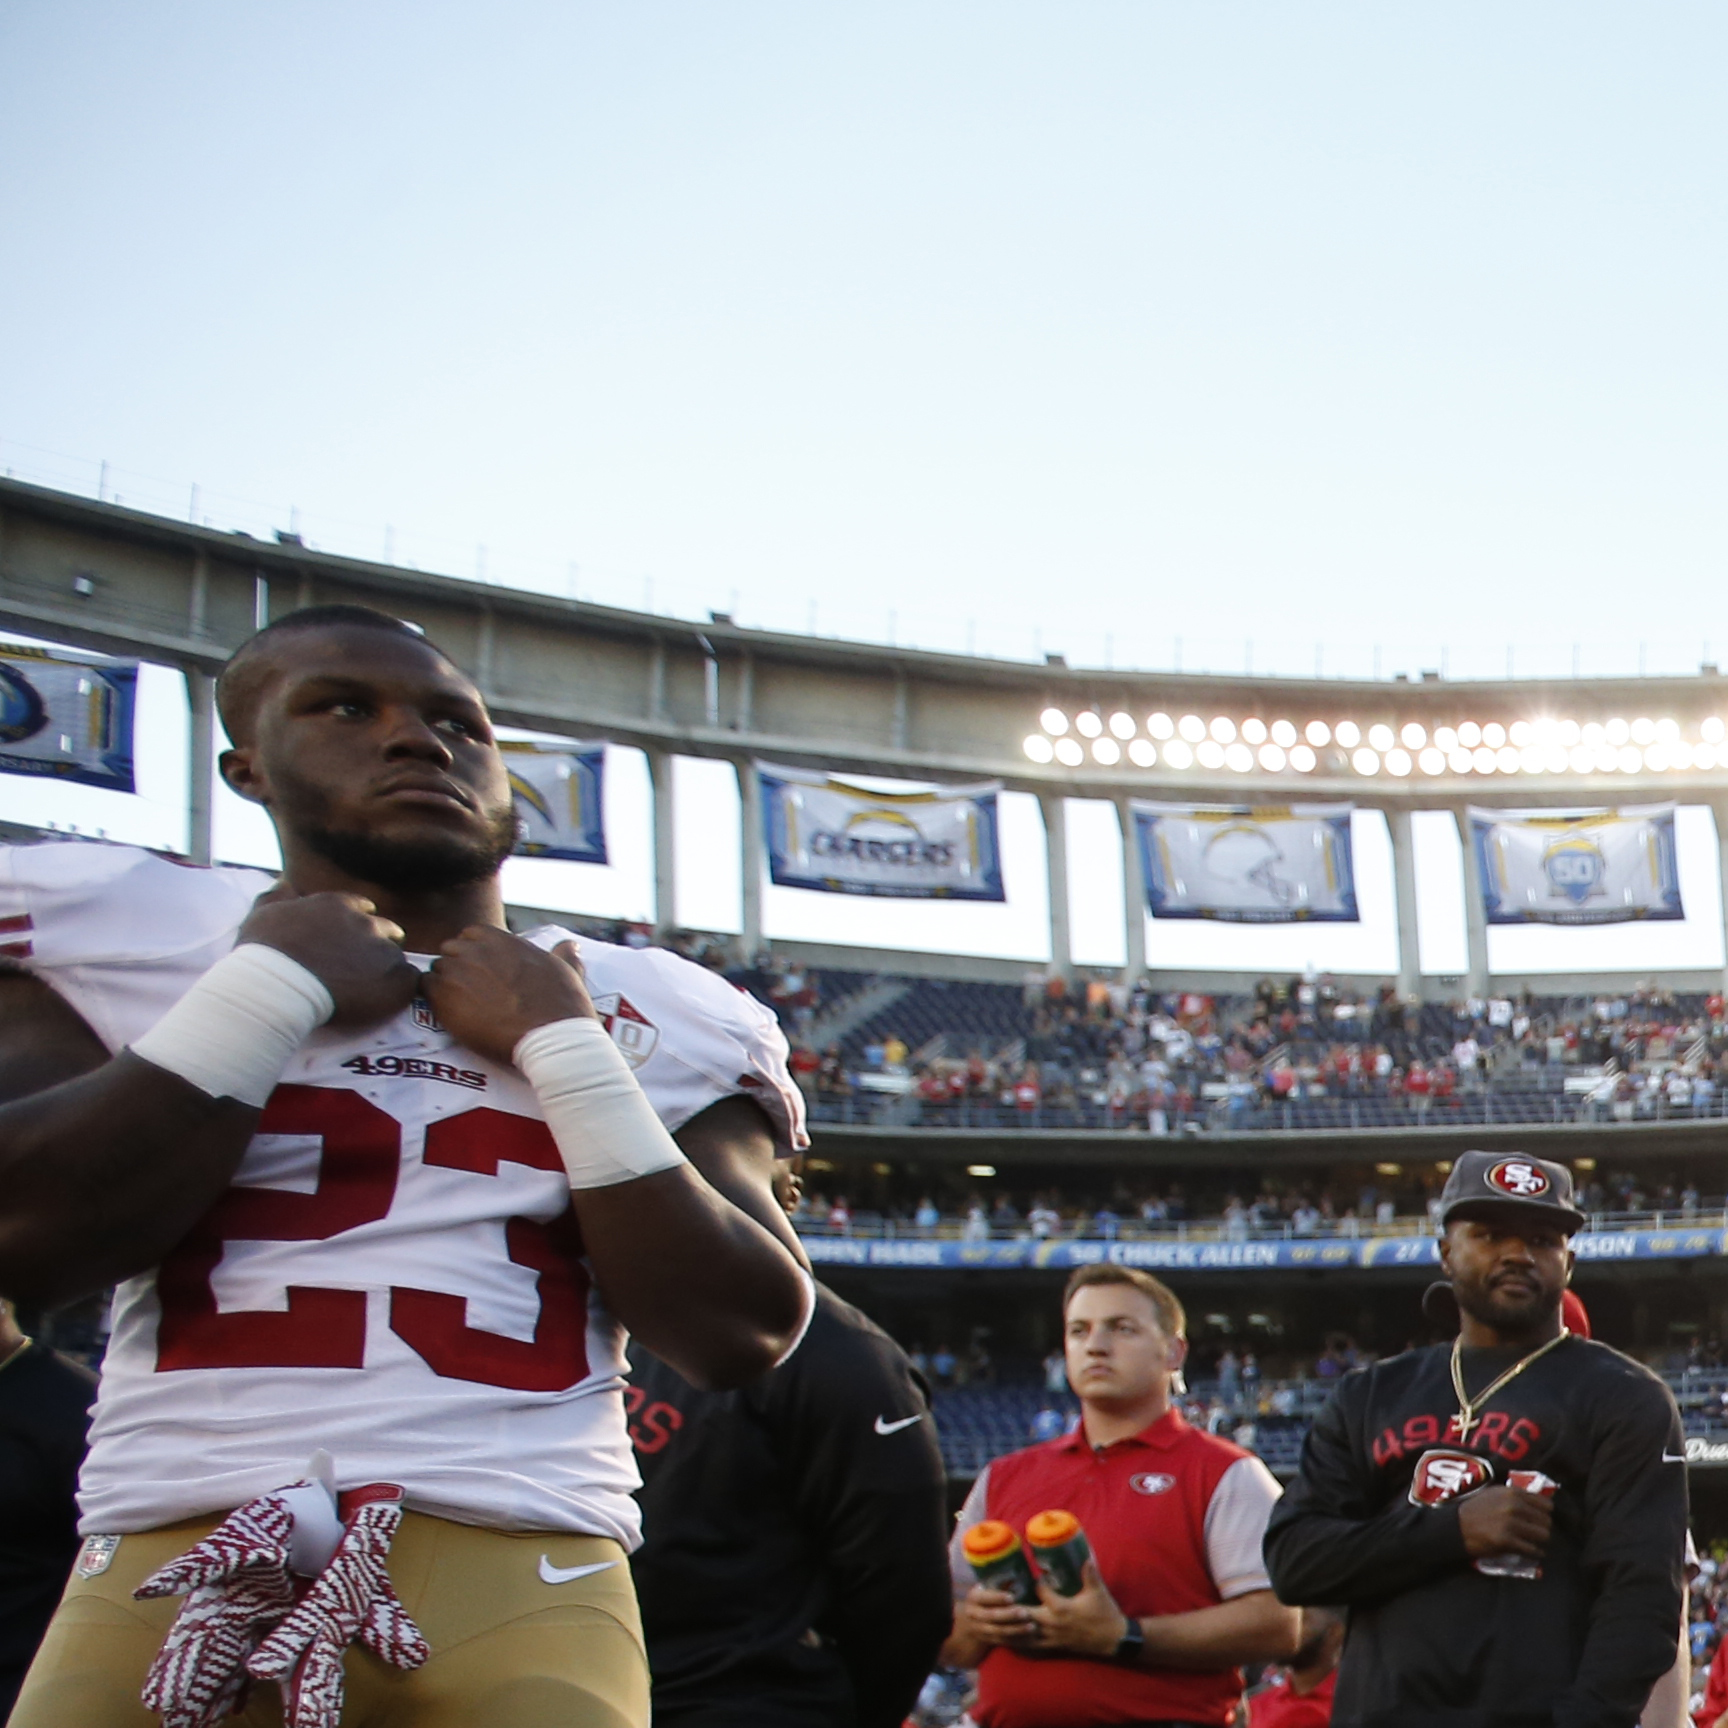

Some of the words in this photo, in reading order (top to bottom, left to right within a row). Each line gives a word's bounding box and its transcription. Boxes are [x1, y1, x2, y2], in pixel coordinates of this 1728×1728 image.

[341, 1054, 488, 1091] 49ERS
[1504, 1163, 1544, 1195] SF
[156, 1084, 589, 1393] 23
[1202, 1243, 1278, 1266] ALLEN
[1372, 1411, 1542, 1468] 49ERS
